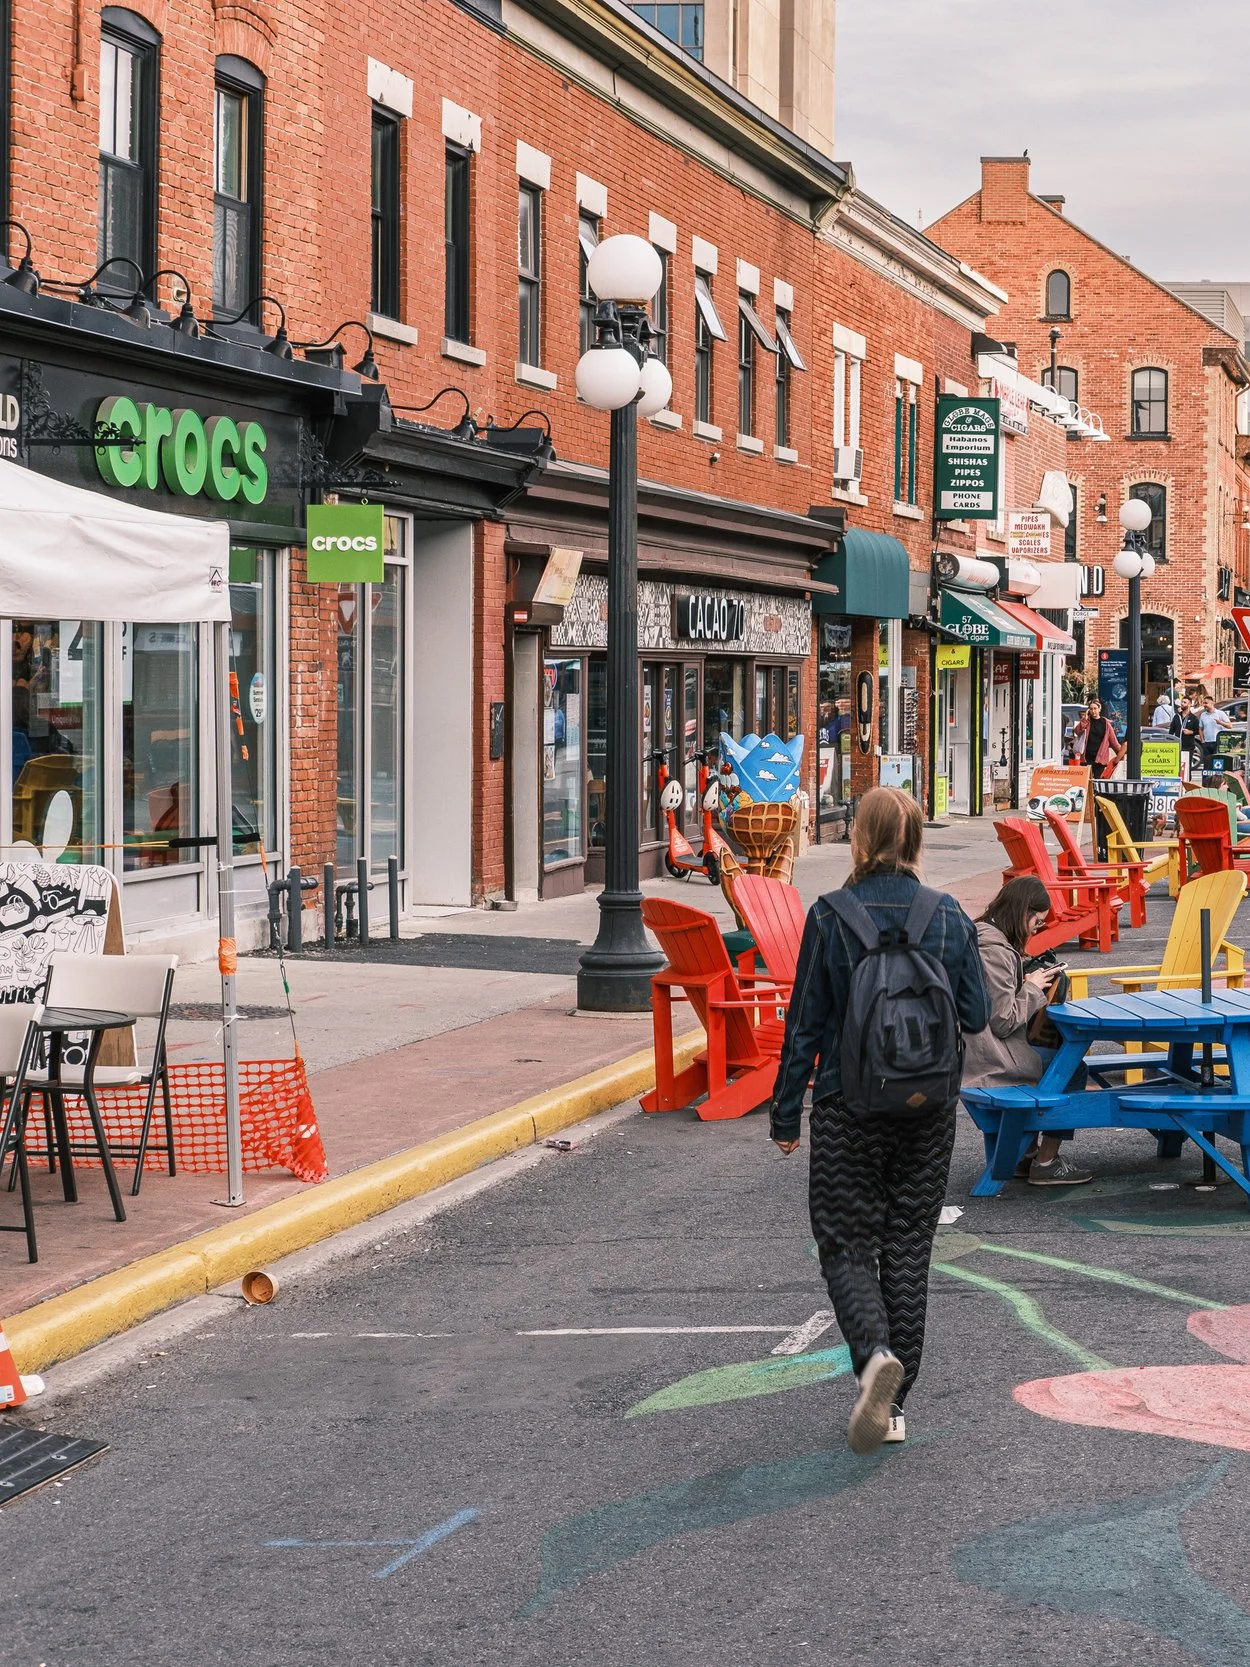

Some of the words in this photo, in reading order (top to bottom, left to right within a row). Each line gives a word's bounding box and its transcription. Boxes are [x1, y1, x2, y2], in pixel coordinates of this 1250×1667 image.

[944, 408, 970, 427] GLOBE
[973, 409, 994, 427] MAGS
[95, 396, 268, 504] crocs
[948, 457, 988, 466] SHISHAS
[954, 468, 981, 476] PIPES
[950, 479, 985, 487] ZIPPOS
[311, 536, 378, 551] crocs
[689, 592, 728, 640] CACAO
[732, 599, 745, 640] 70
[961, 615, 972, 623] 57
[945, 623, 990, 635] GLOBE
[970, 634, 990, 642] cigars
